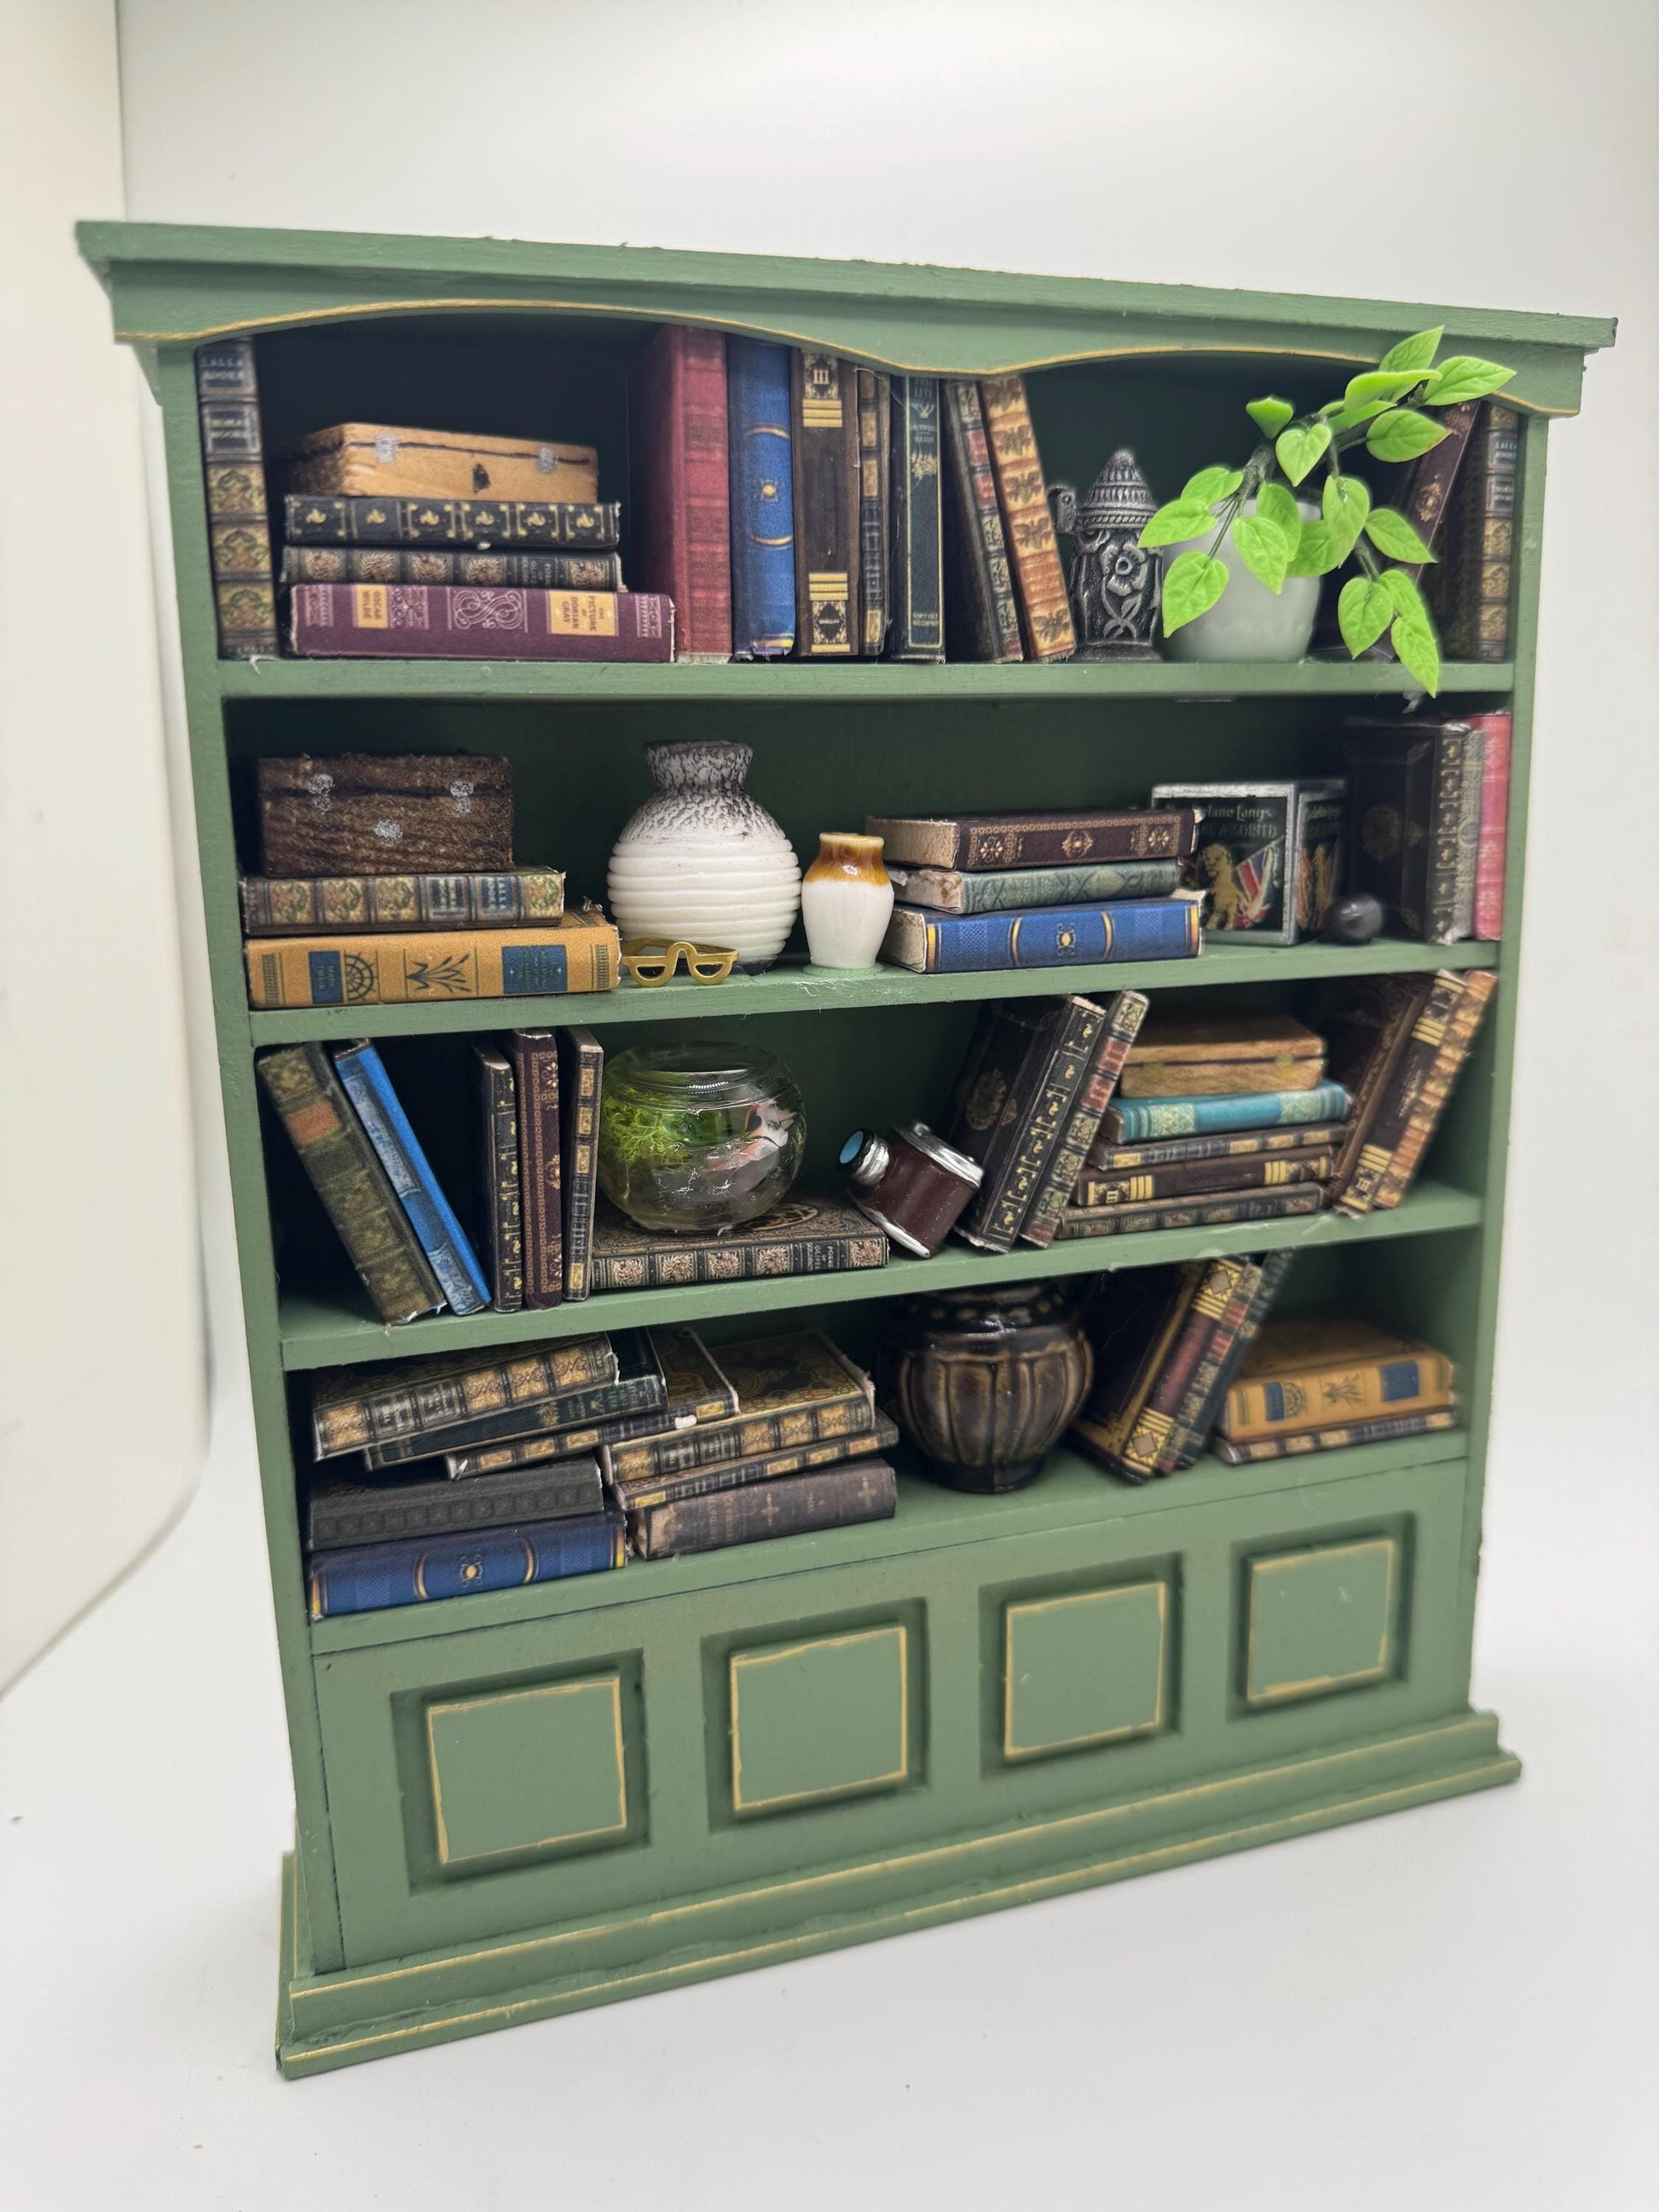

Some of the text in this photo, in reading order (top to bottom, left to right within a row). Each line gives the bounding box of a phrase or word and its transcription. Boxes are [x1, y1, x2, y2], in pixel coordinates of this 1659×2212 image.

[812, 369, 830, 385] III
[373, 591, 382, 620] OSCAR
[562, 601, 570, 624] GRAY
[570, 597, 579, 629] DORIAN
[588, 595, 597, 632] PICTURE
